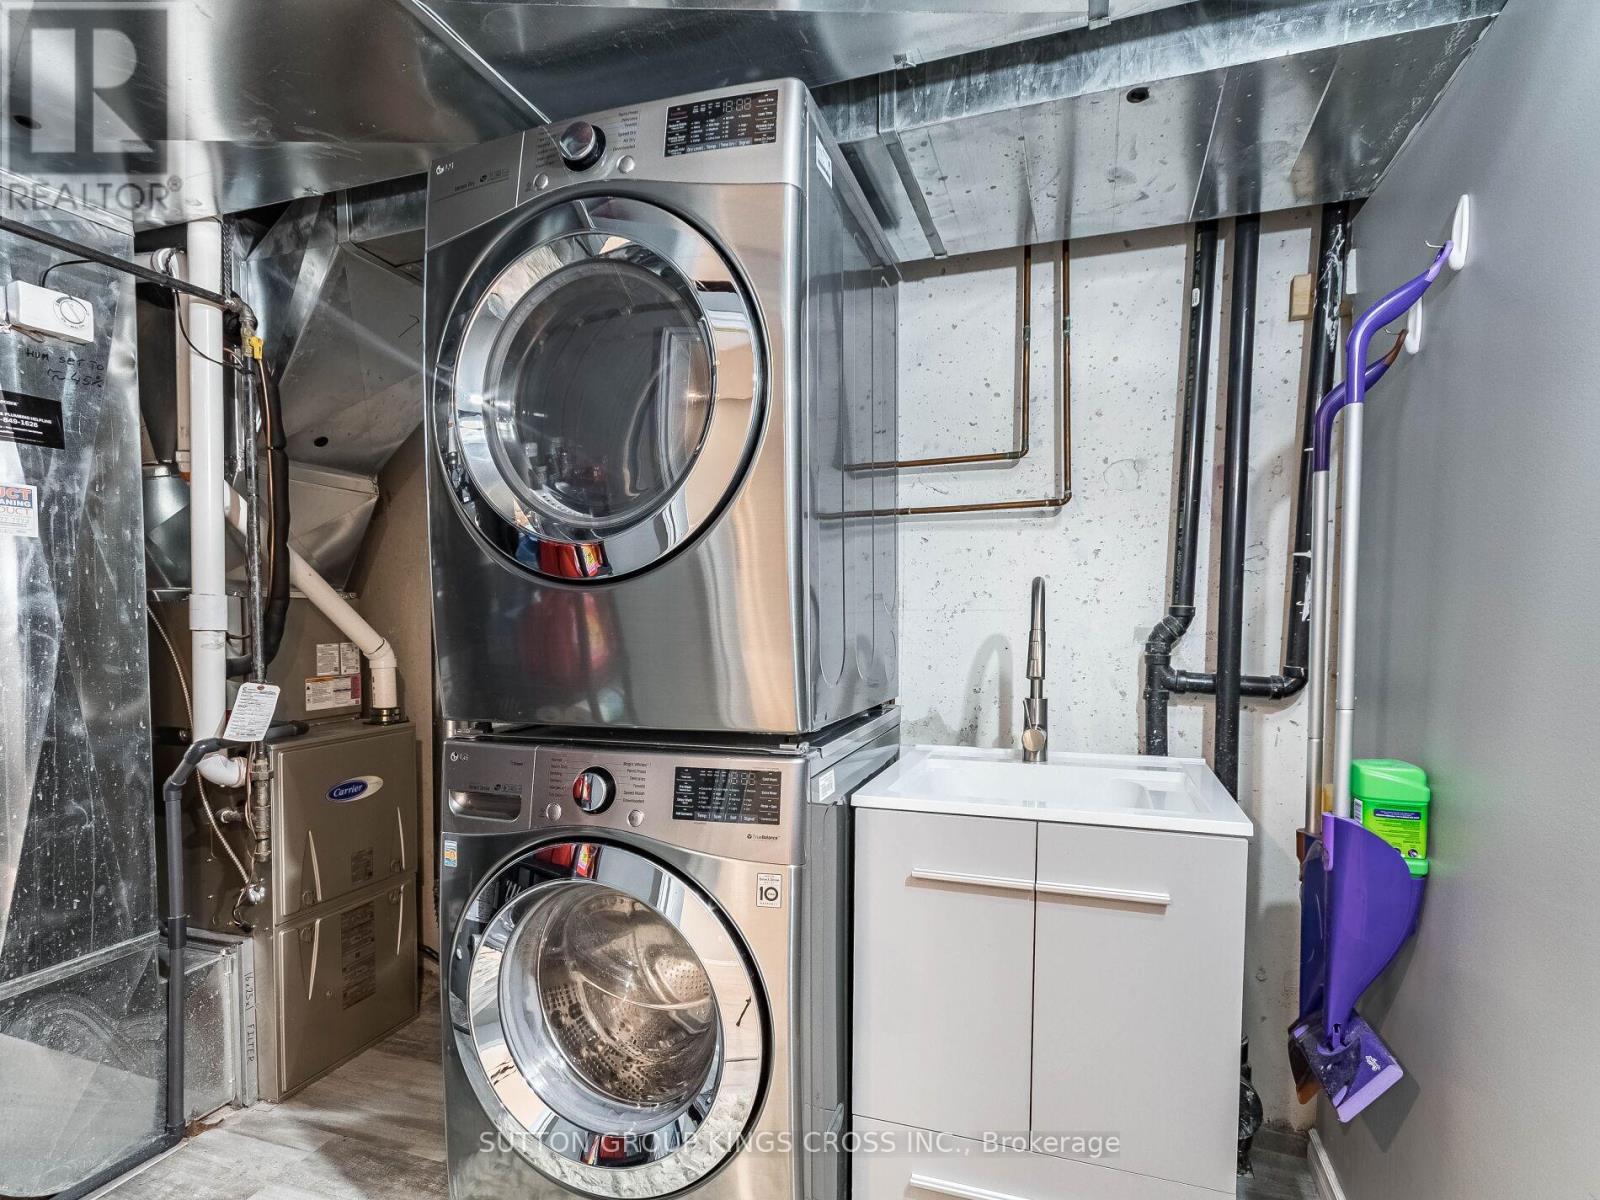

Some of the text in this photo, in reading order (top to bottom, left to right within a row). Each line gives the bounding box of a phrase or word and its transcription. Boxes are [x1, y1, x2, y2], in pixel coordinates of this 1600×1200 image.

[26, 347, 50, 361] HUM
[333, 784, 363, 797] Carrier
[759, 886, 779, 902] 10
[246, 1023, 256, 1065] FILTER
